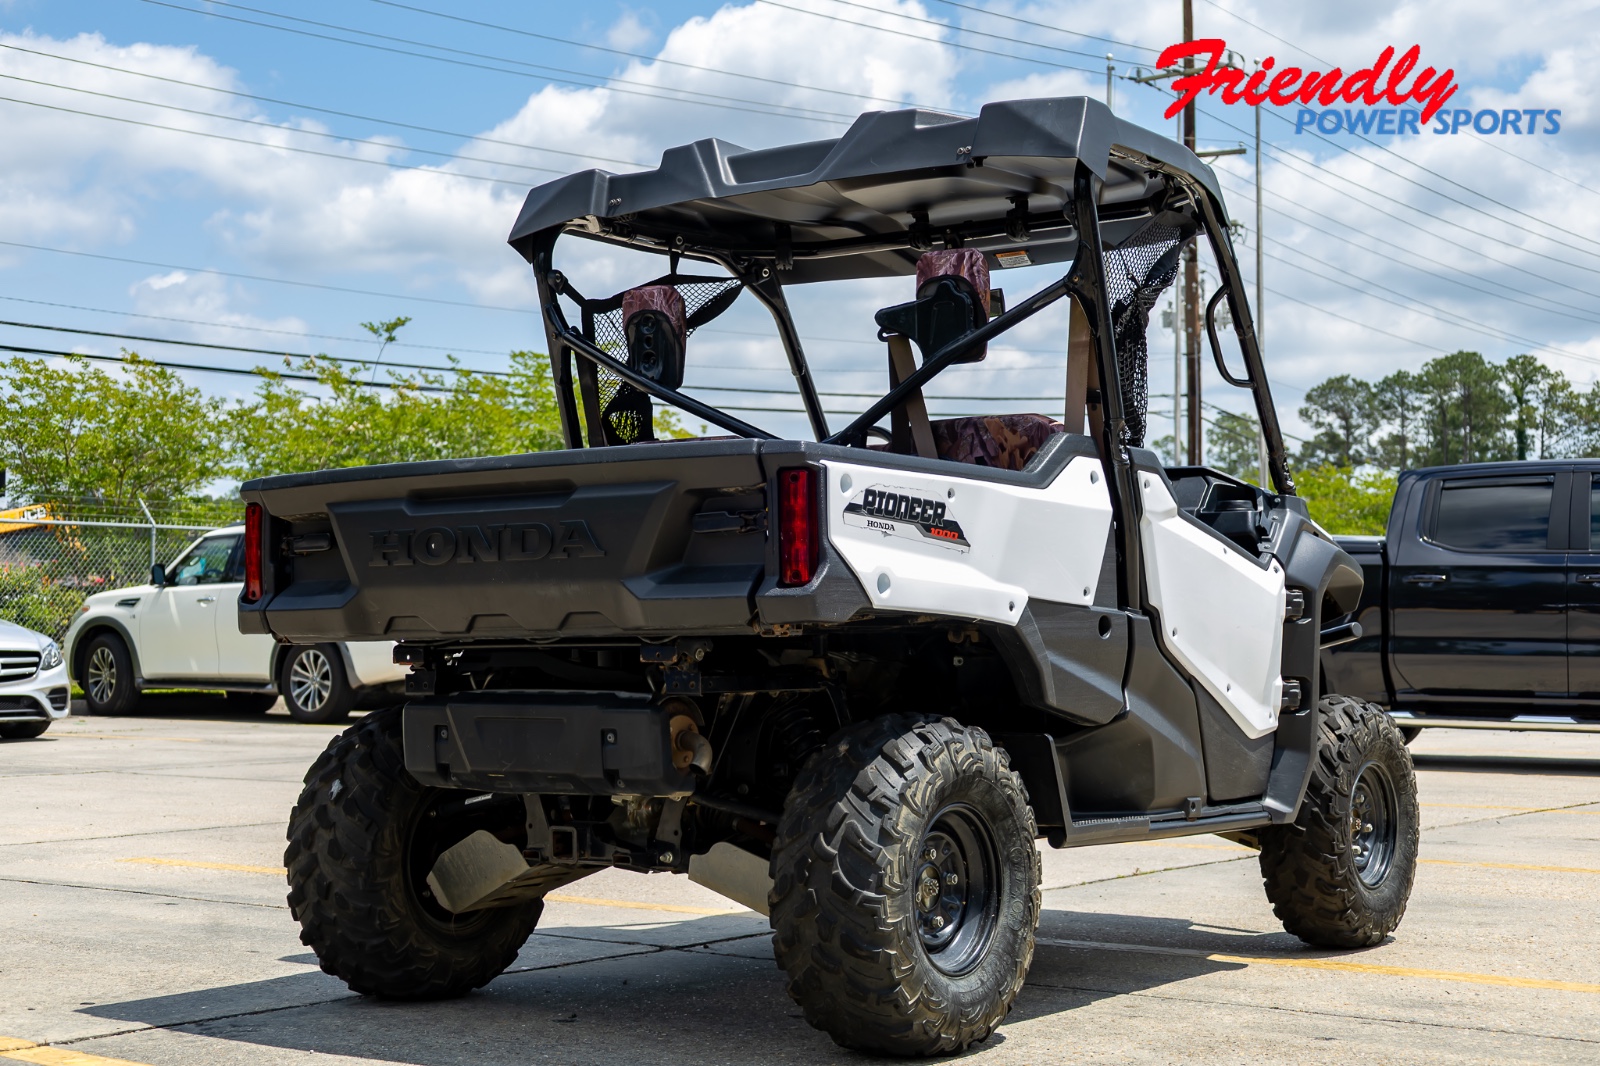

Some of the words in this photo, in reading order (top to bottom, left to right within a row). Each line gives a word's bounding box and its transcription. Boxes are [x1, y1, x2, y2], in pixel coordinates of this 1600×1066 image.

[21, 507, 46, 520] JCB
[862, 488, 946, 526] PIONEER
[866, 519, 895, 531] HONDA
[930, 527, 958, 540] 1000
[368, 519, 607, 567] HONDA
